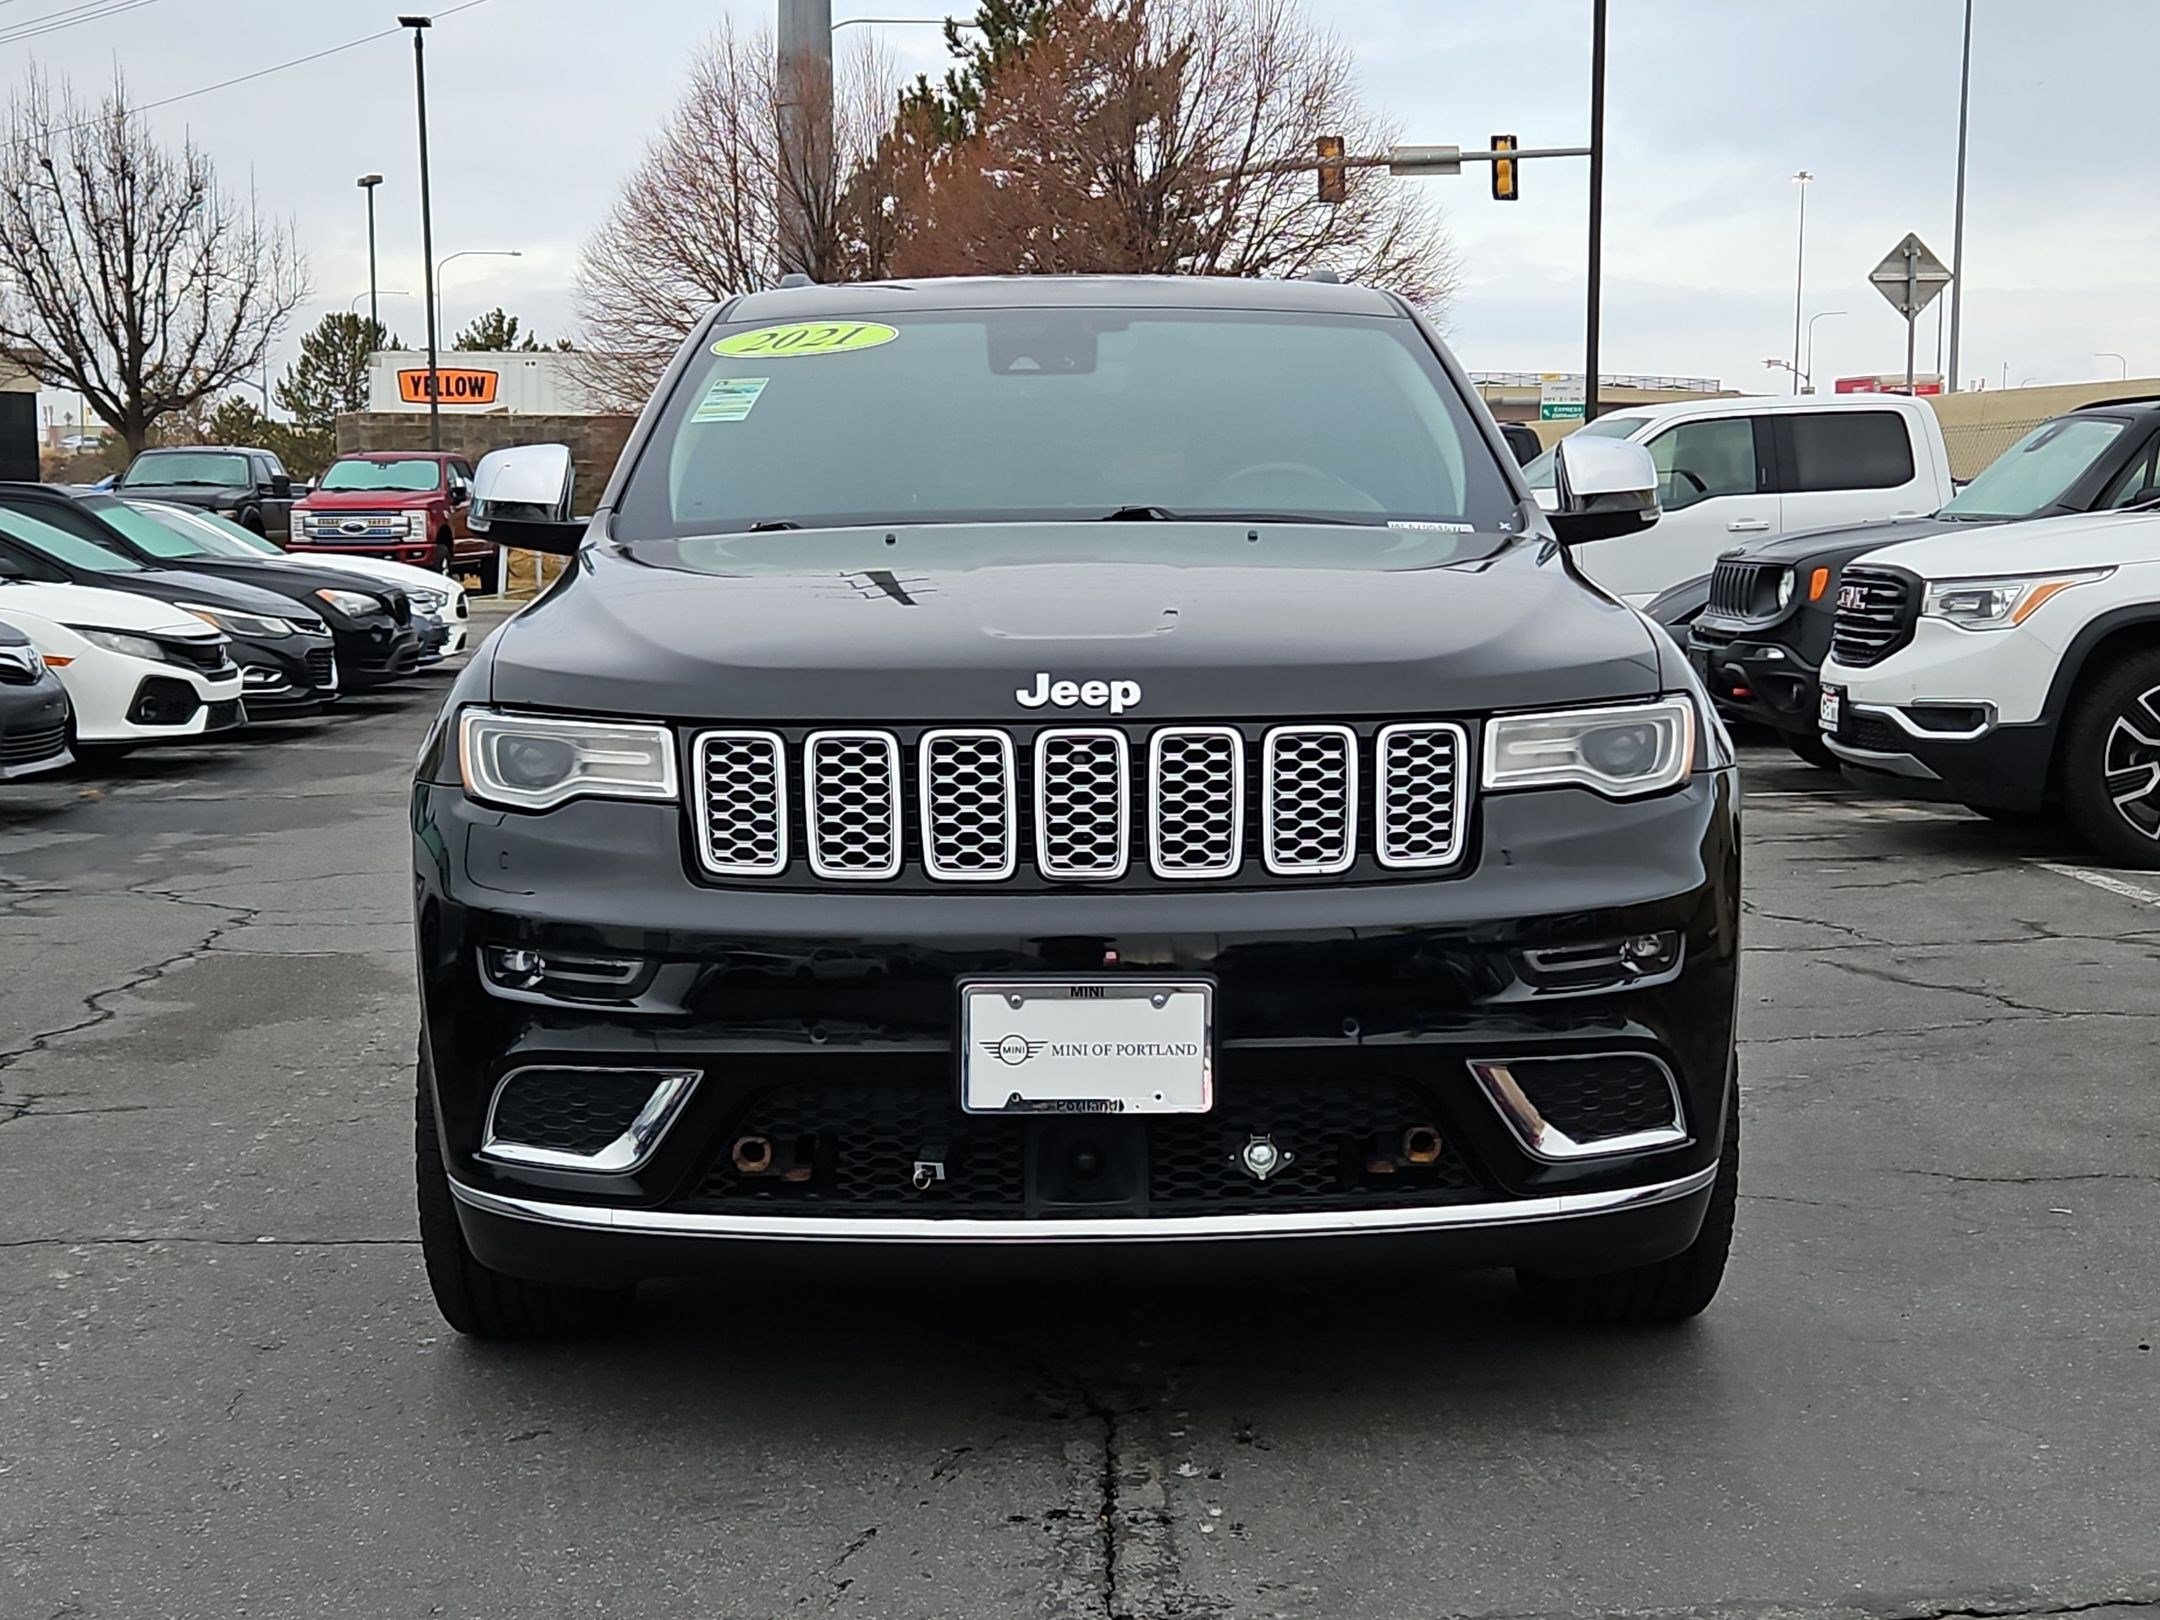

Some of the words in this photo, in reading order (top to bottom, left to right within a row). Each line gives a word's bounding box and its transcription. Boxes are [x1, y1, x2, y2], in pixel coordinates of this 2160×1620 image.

[738, 326, 866, 352] 2021
[410, 375, 486, 397] YELLOW
[1016, 672, 1141, 714] Jeep
[1070, 986, 1105, 998] MINI
[1002, 1046, 1025, 1055] MINI
[1051, 1043, 1088, 1057] MINI
[1092, 1043, 1112, 1057] OF
[1116, 1043, 1198, 1057] PORTLAND
[1056, 1099, 1119, 1113] Portland
